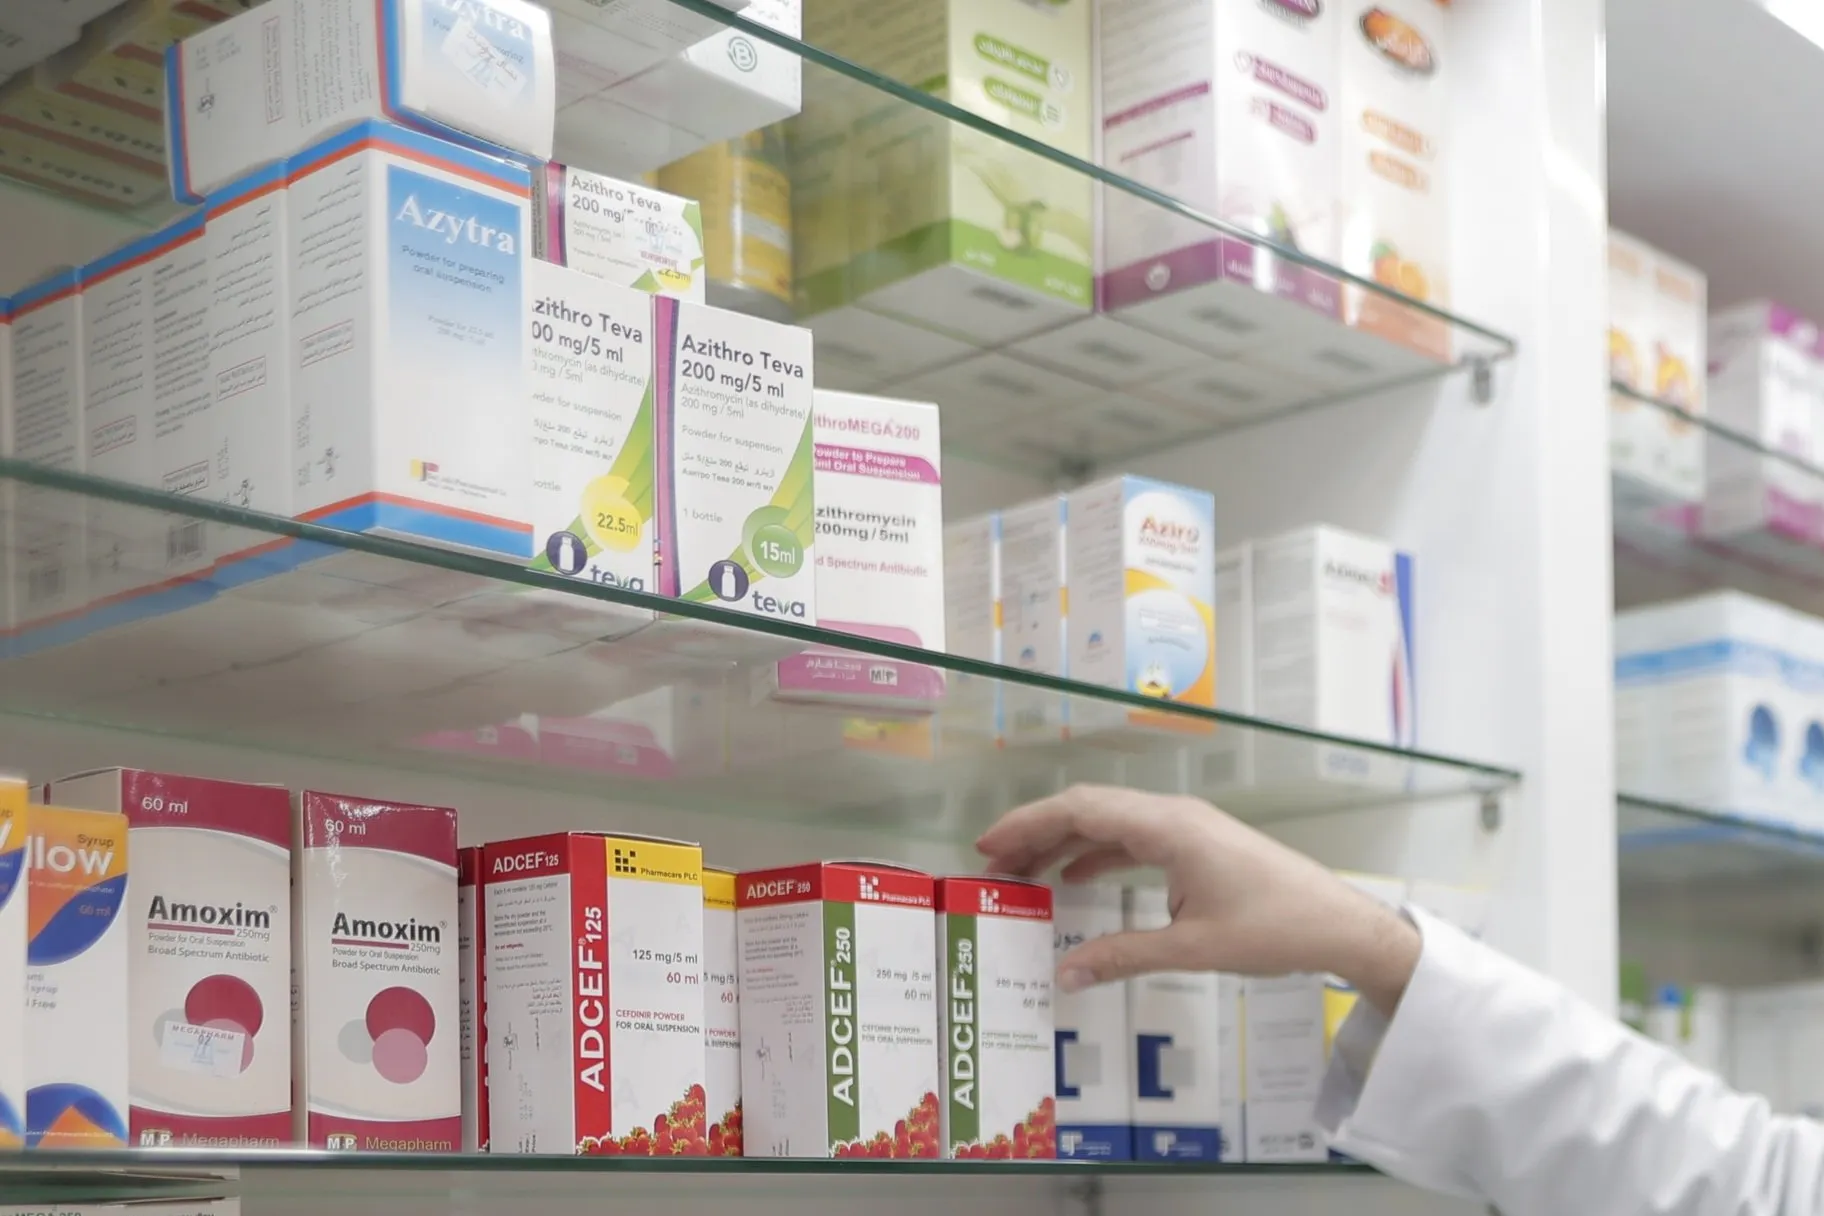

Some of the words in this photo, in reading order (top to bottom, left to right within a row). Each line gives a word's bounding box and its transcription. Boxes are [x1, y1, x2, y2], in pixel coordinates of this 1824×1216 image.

[571, 174, 624, 202] Azithro
[627, 190, 662, 213] Teva
[395, 194, 516, 257] Azytra
[402, 244, 440, 266] Powder
[443, 257, 456, 269] for
[458, 263, 506, 285] preparing
[413, 264, 434, 279] oral
[436, 270, 493, 294] suspension
[532, 297, 593, 328] zithro
[599, 312, 643, 343] Teva
[682, 333, 754, 366] Azithro
[760, 351, 804, 379] Teva
[682, 359, 716, 382] 200
[721, 372, 762, 393] mg/5
[768, 382, 785, 398] ml
[814, 413, 894, 438] ithroMEGA
[895, 425, 920, 441] 200
[597, 512, 639, 538] 22.5ml
[816, 506, 917, 529] zithromycin
[760, 541, 796, 565] 15ml
[590, 564, 644, 592] teva
[752, 590, 806, 618] teva
[142, 796, 163, 811] 60
[168, 801, 188, 814] ml
[325, 818, 344, 834] 60
[349, 822, 366, 835] ml
[78, 833, 114, 847] Syrup
[28, 834, 113, 876] llow
[493, 851, 545, 875] ADCEF
[545, 854, 560, 867] 125
[641, 867, 682, 880] Pharmacare
[684, 870, 698, 881] PLC
[746, 880, 794, 900] ADCEF
[236, 929, 270, 942] 250mg
[585, 906, 603, 943] 125
[148, 945, 177, 957] Broad
[179, 948, 224, 963] Spectrum
[225, 951, 269, 964] Antibiotic
[411, 943, 440, 955] 250mg
[836, 927, 852, 963] 250
[332, 959, 358, 970] Broad
[360, 960, 399, 974] Spectrum
[401, 964, 440, 976] Antibiotic
[633, 950, 652, 961] 125
[655, 951, 683, 964] mg/5
[685, 954, 698, 964] ml
[666, 972, 682, 984] 60
[685, 973, 698, 985] ml
[721, 992, 734, 1004] 60
[616, 1009, 652, 1021] CEFDINIR
[653, 1012, 685, 1022] POWDER
[172, 1024, 235, 1042] MEGAPHARM
[616, 1021, 632, 1031] FOR
[634, 1022, 654, 1032] ORAL
[656, 1023, 700, 1035] SUSPENSION
